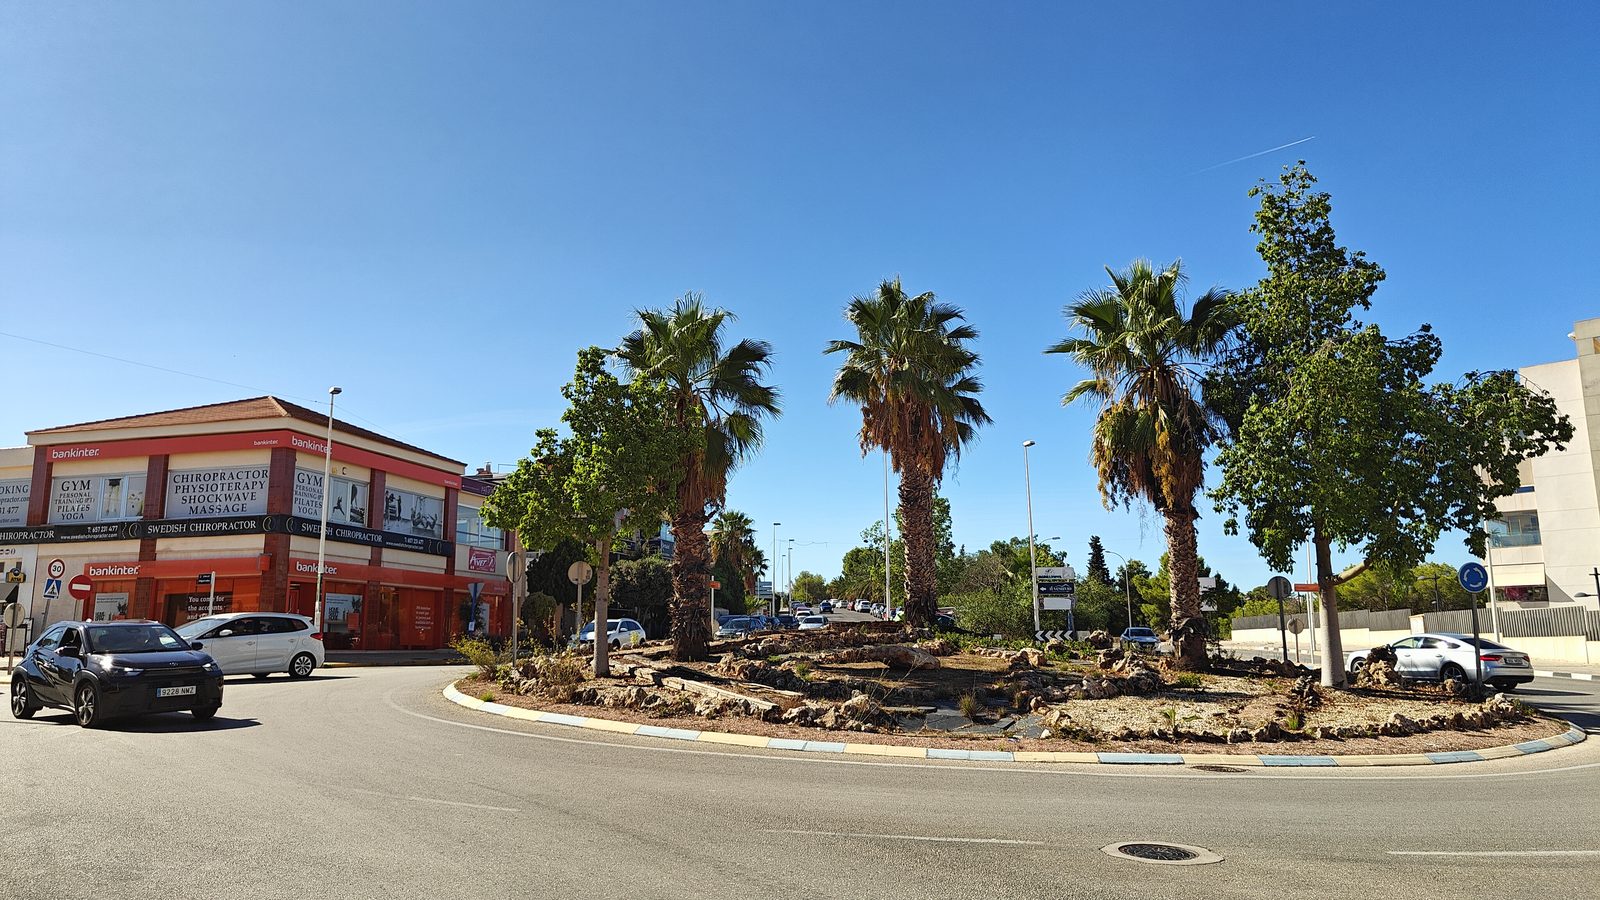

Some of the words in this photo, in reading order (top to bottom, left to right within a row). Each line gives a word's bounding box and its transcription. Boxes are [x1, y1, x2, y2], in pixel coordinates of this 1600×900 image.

[52, 448, 99, 458] bankinter
[173, 469, 269, 483] CHIROPRACTOR
[297, 472, 323, 487] GYM
[61, 479, 91, 491] GYM
[175, 480, 266, 493] PHYSIOTERAPY
[181, 492, 257, 504] SHOCKWAVE
[294, 497, 323, 509] PILATES
[57, 504, 90, 512] PILATES
[188, 503, 248, 515] MASSAGE
[298, 506, 318, 516] YOGA
[147, 523, 187, 534] SWEDISH
[189, 520, 257, 532] CHIROPRACTOR
[301, 522, 333, 536] SWESH
[335, 528, 383, 543] CHIROPRACTOR
[52, 565, 62, 573] 30
[89, 565, 140, 576] bankinter
[296, 561, 337, 574] bankter
[161, 688, 180, 696] 9228
